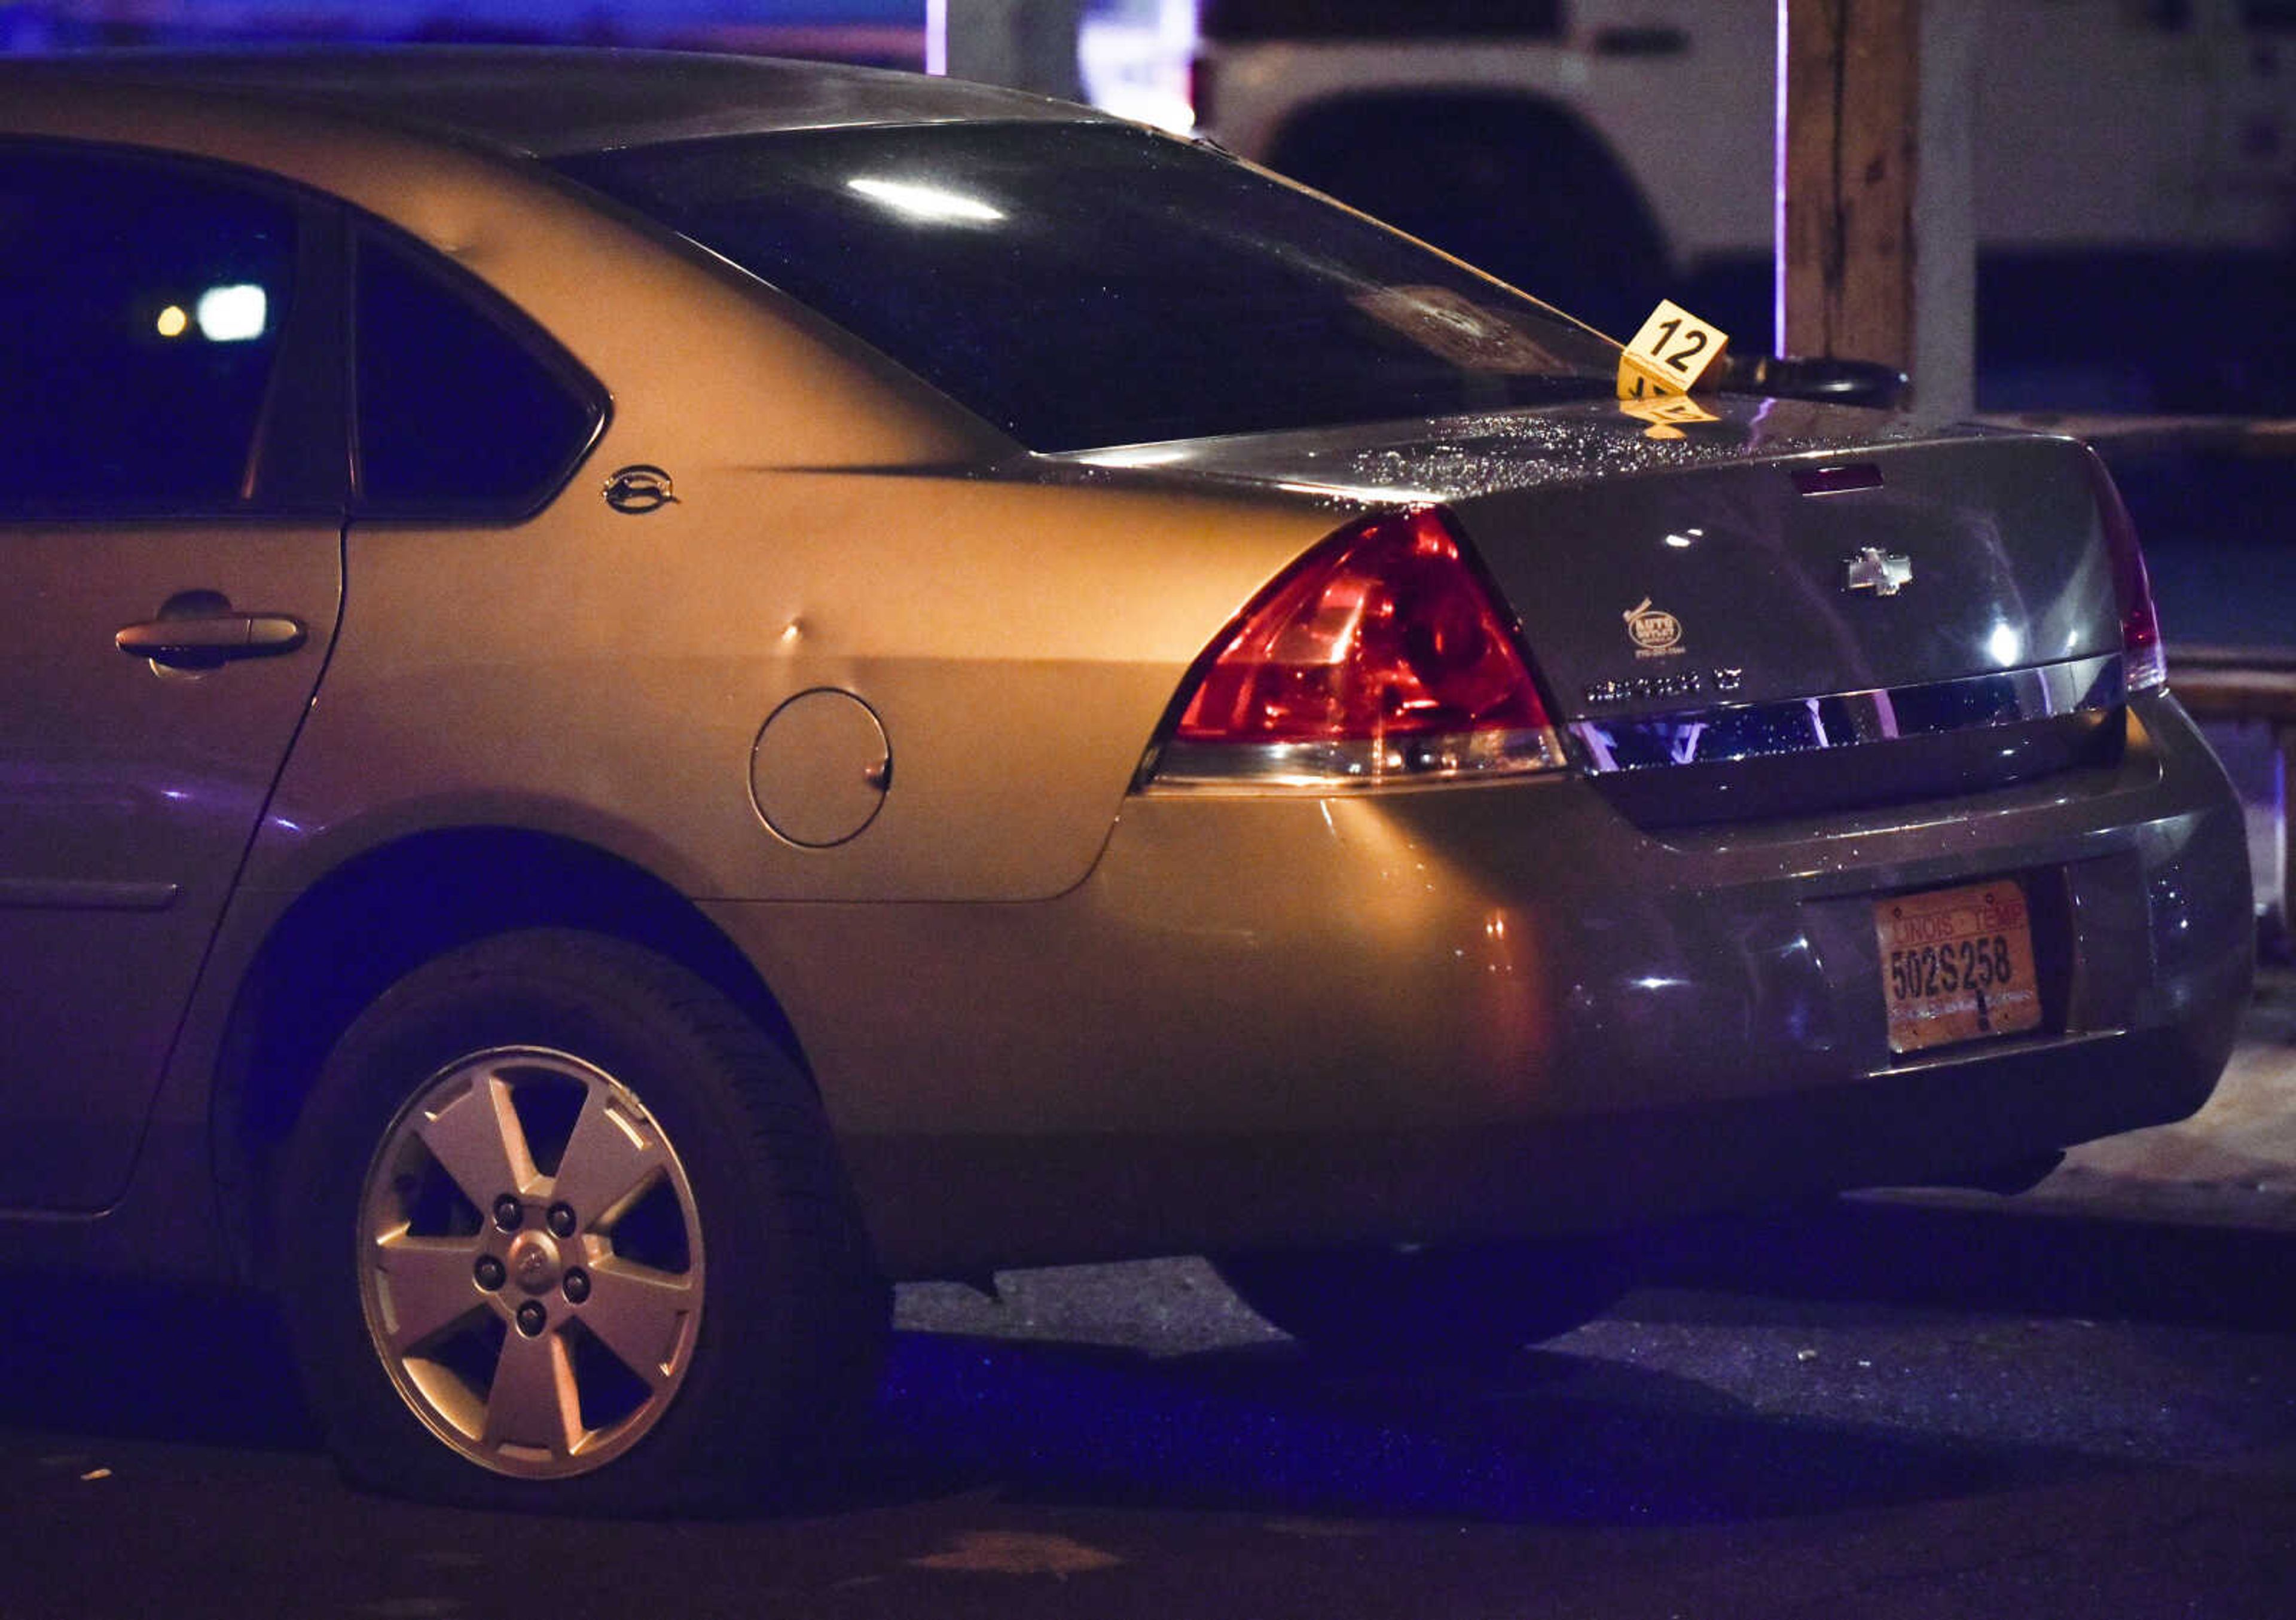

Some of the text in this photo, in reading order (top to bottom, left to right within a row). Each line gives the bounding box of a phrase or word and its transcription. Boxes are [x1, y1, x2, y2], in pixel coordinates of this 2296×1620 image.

[1650, 318, 1708, 373] 12
[1889, 913, 1954, 943] LINOIS
[1891, 934, 2011, 1001] 502S258
